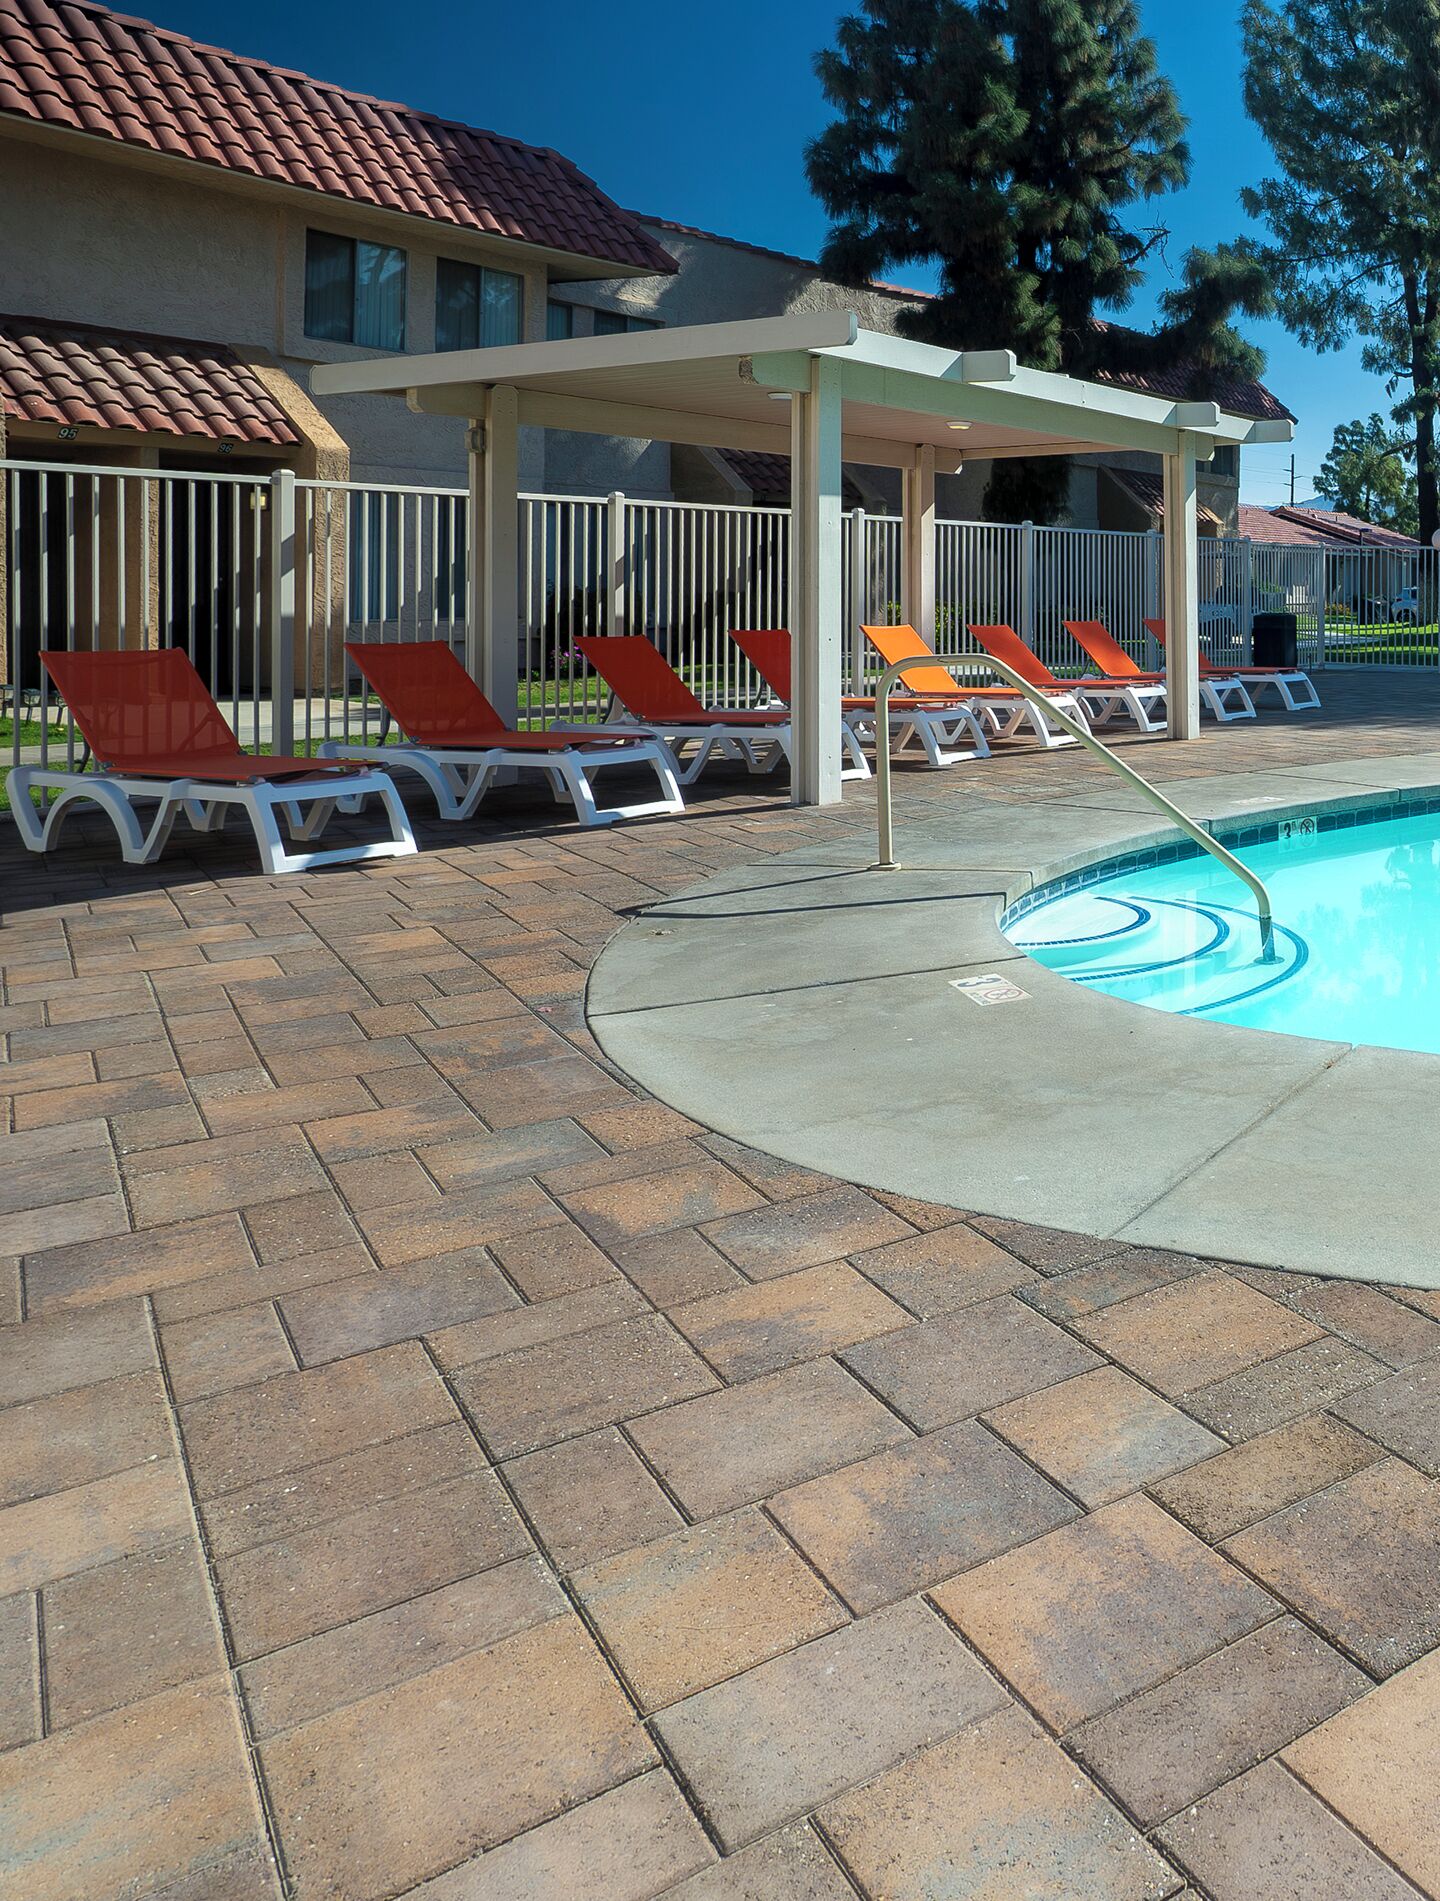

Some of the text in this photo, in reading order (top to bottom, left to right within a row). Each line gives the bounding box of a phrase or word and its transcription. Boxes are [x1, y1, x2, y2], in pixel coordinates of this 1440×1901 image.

[58, 427, 78, 439] 95
[219, 443, 233, 453] 96
[957, 978, 1002, 988] 3
